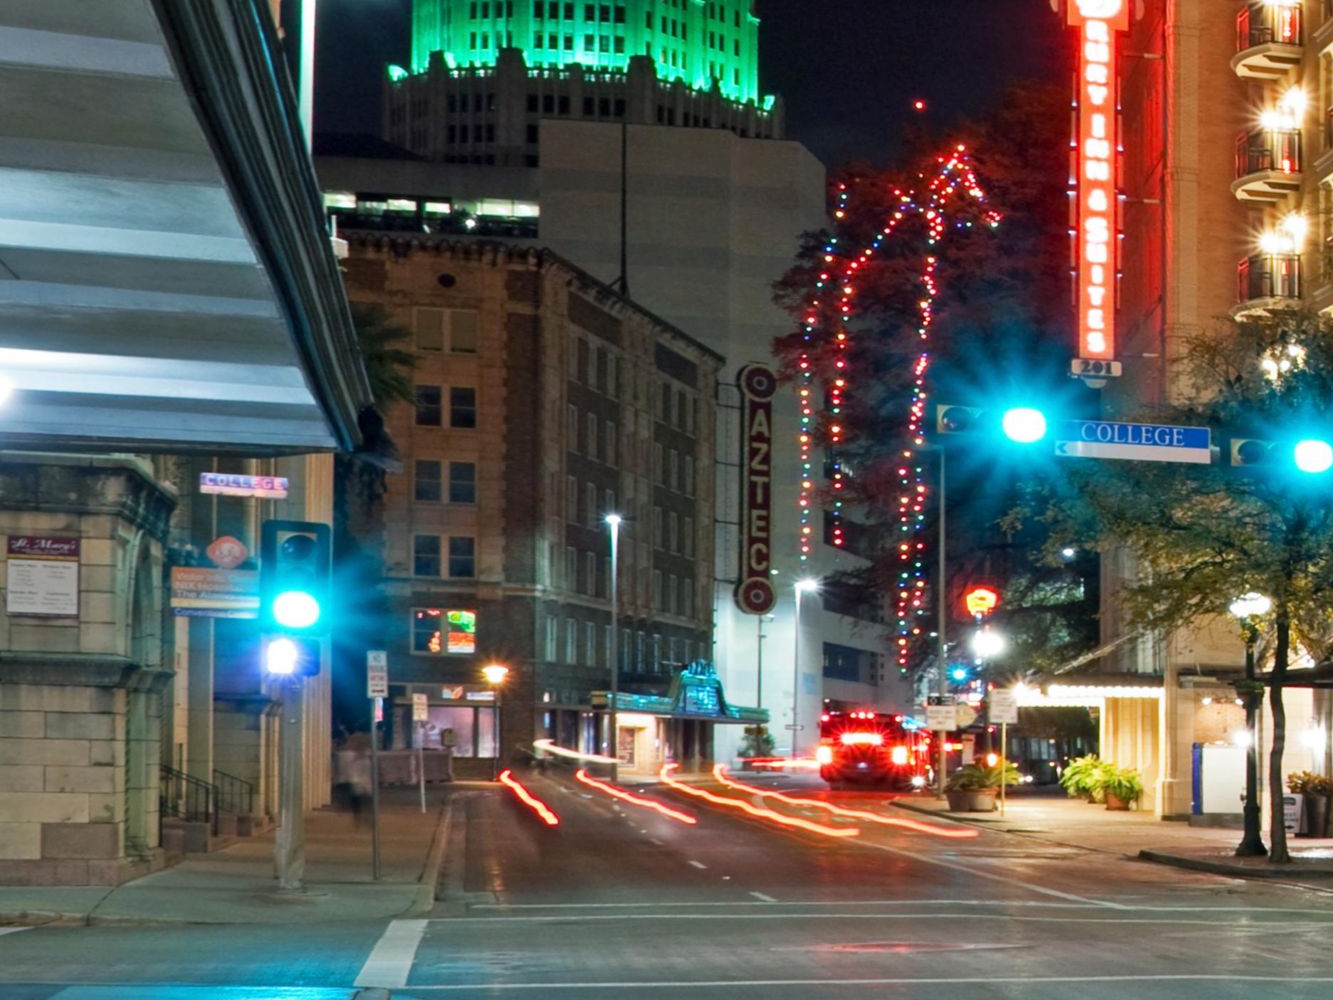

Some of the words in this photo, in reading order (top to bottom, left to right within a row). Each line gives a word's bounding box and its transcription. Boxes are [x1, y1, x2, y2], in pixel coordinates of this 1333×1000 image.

[1085, 113, 1109, 181] INN
[1085, 216, 1109, 353] SUITES
[1081, 360, 1113, 375] 201
[1081, 422, 1185, 446] COLLEGE
[206, 474, 283, 489] COLLEGE
[750, 408, 770, 571] AZTEC
